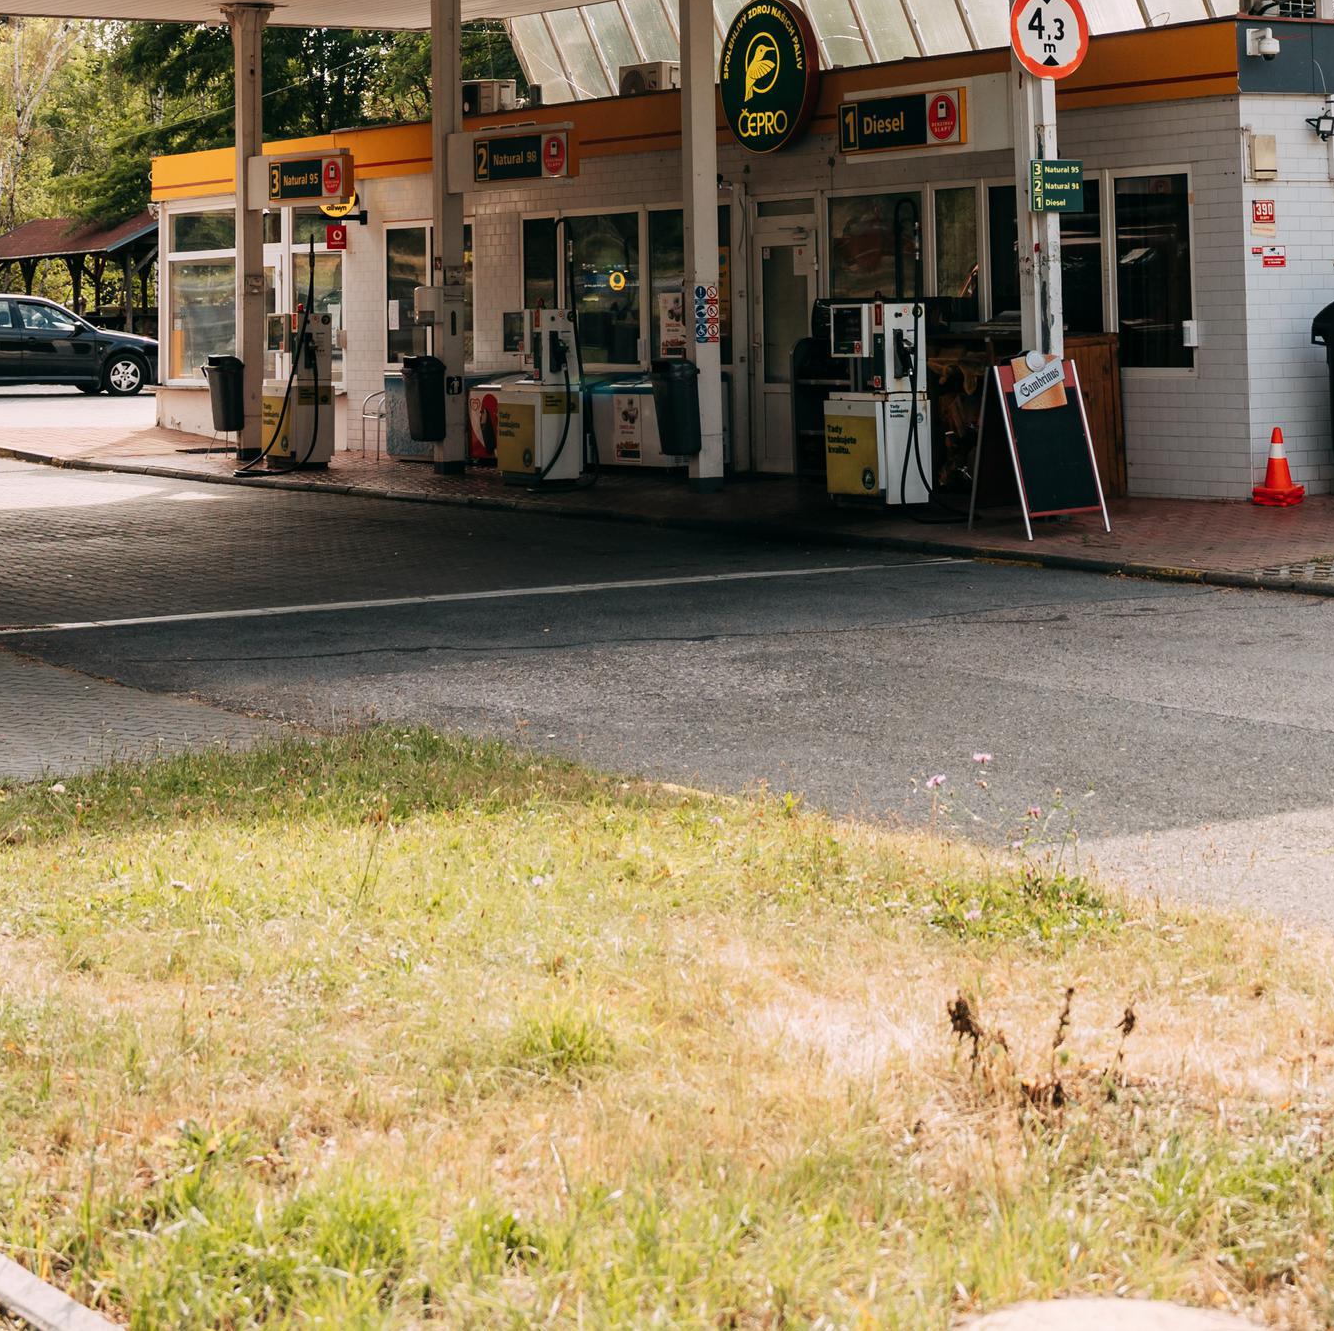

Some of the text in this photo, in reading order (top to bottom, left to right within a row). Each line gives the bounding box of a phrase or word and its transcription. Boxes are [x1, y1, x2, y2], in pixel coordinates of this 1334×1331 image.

[1028, 7, 1064, 41] 4,3
[723, 4, 803, 80] SPOLEHLIVÝ ZDROJ NAŠICH PALIV
[1043, 43, 1056, 53] m
[738, 108, 788, 138] ČEPRO
[845, 110, 904, 143] 1 Diesel
[478, 148, 487, 175] 2
[493, 151, 524, 167] Natural
[1034, 164, 1042, 175] 3
[1044, 166, 1070, 174] Natural
[272, 170, 319, 194] 3 Natural 95
[1034, 180, 1042, 192] 2
[1045, 182, 1070, 190] Natural
[1035, 196, 1042, 208] 1
[1255, 203, 1273, 215] 390
[1020, 368, 1060, 397] Gambrinus
[827, 424, 843, 434] Tady
